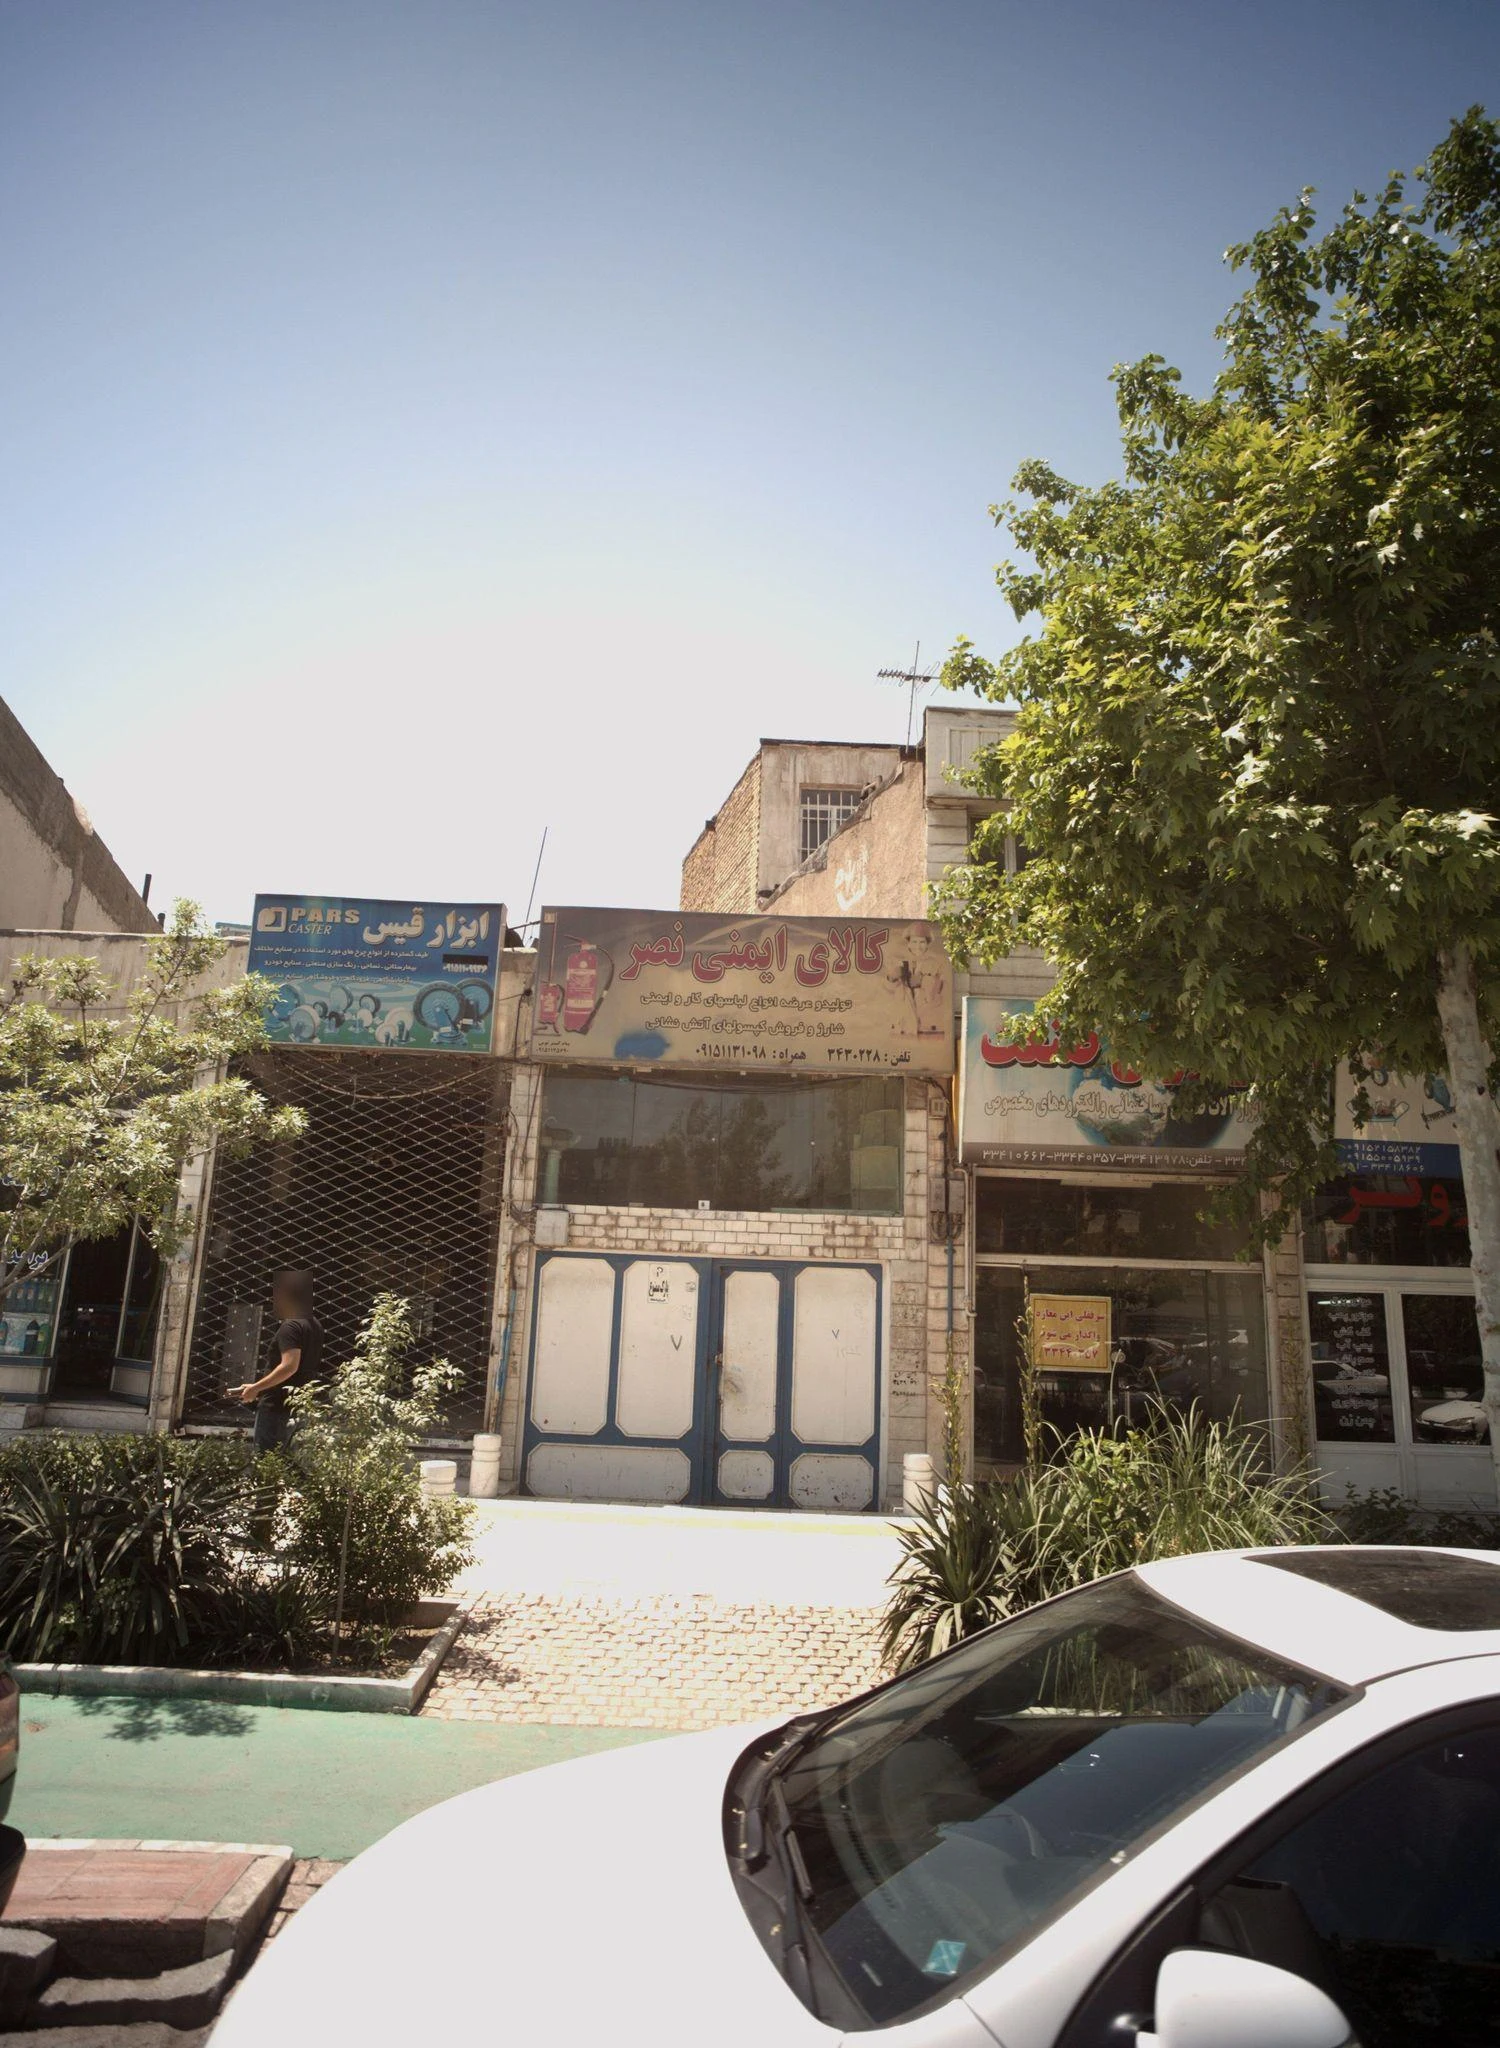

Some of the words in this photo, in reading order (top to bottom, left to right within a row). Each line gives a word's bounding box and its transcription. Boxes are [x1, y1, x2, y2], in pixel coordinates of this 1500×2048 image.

[290, 907, 360, 924] PARS
[287, 922, 333, 935] CASTER
[362, 906, 425, 945] قیس
[426, 909, 490, 948] ابزار
[618, 920, 684, 981] نصر
[691, 922, 788, 983] ایمنی
[795, 926, 890, 988] کالای
[640, 991, 672, 1006] ایمنی
[673, 994, 682, 1007] و
[683, 992, 702, 1007] کار
[703, 994, 747, 1009] لباسهای
[748, 996, 778, 1012] انواع
[780, 998, 813, 1012] عرضه
[645, 1015, 680, 1032] نشانی
[681, 1016, 712, 1032] آتش
[712, 1018, 767, 1037] کپسولهای
[768, 1019, 806, 1037] فروش
[806, 1022, 815, 1037] و
[815, 1021, 845, 1038] شارژ
[695, 1042, 767, 1060] ۰۹۱۵۱۱۳۱۰۹۸
[984, 1089, 1035, 1117] مخصوص
